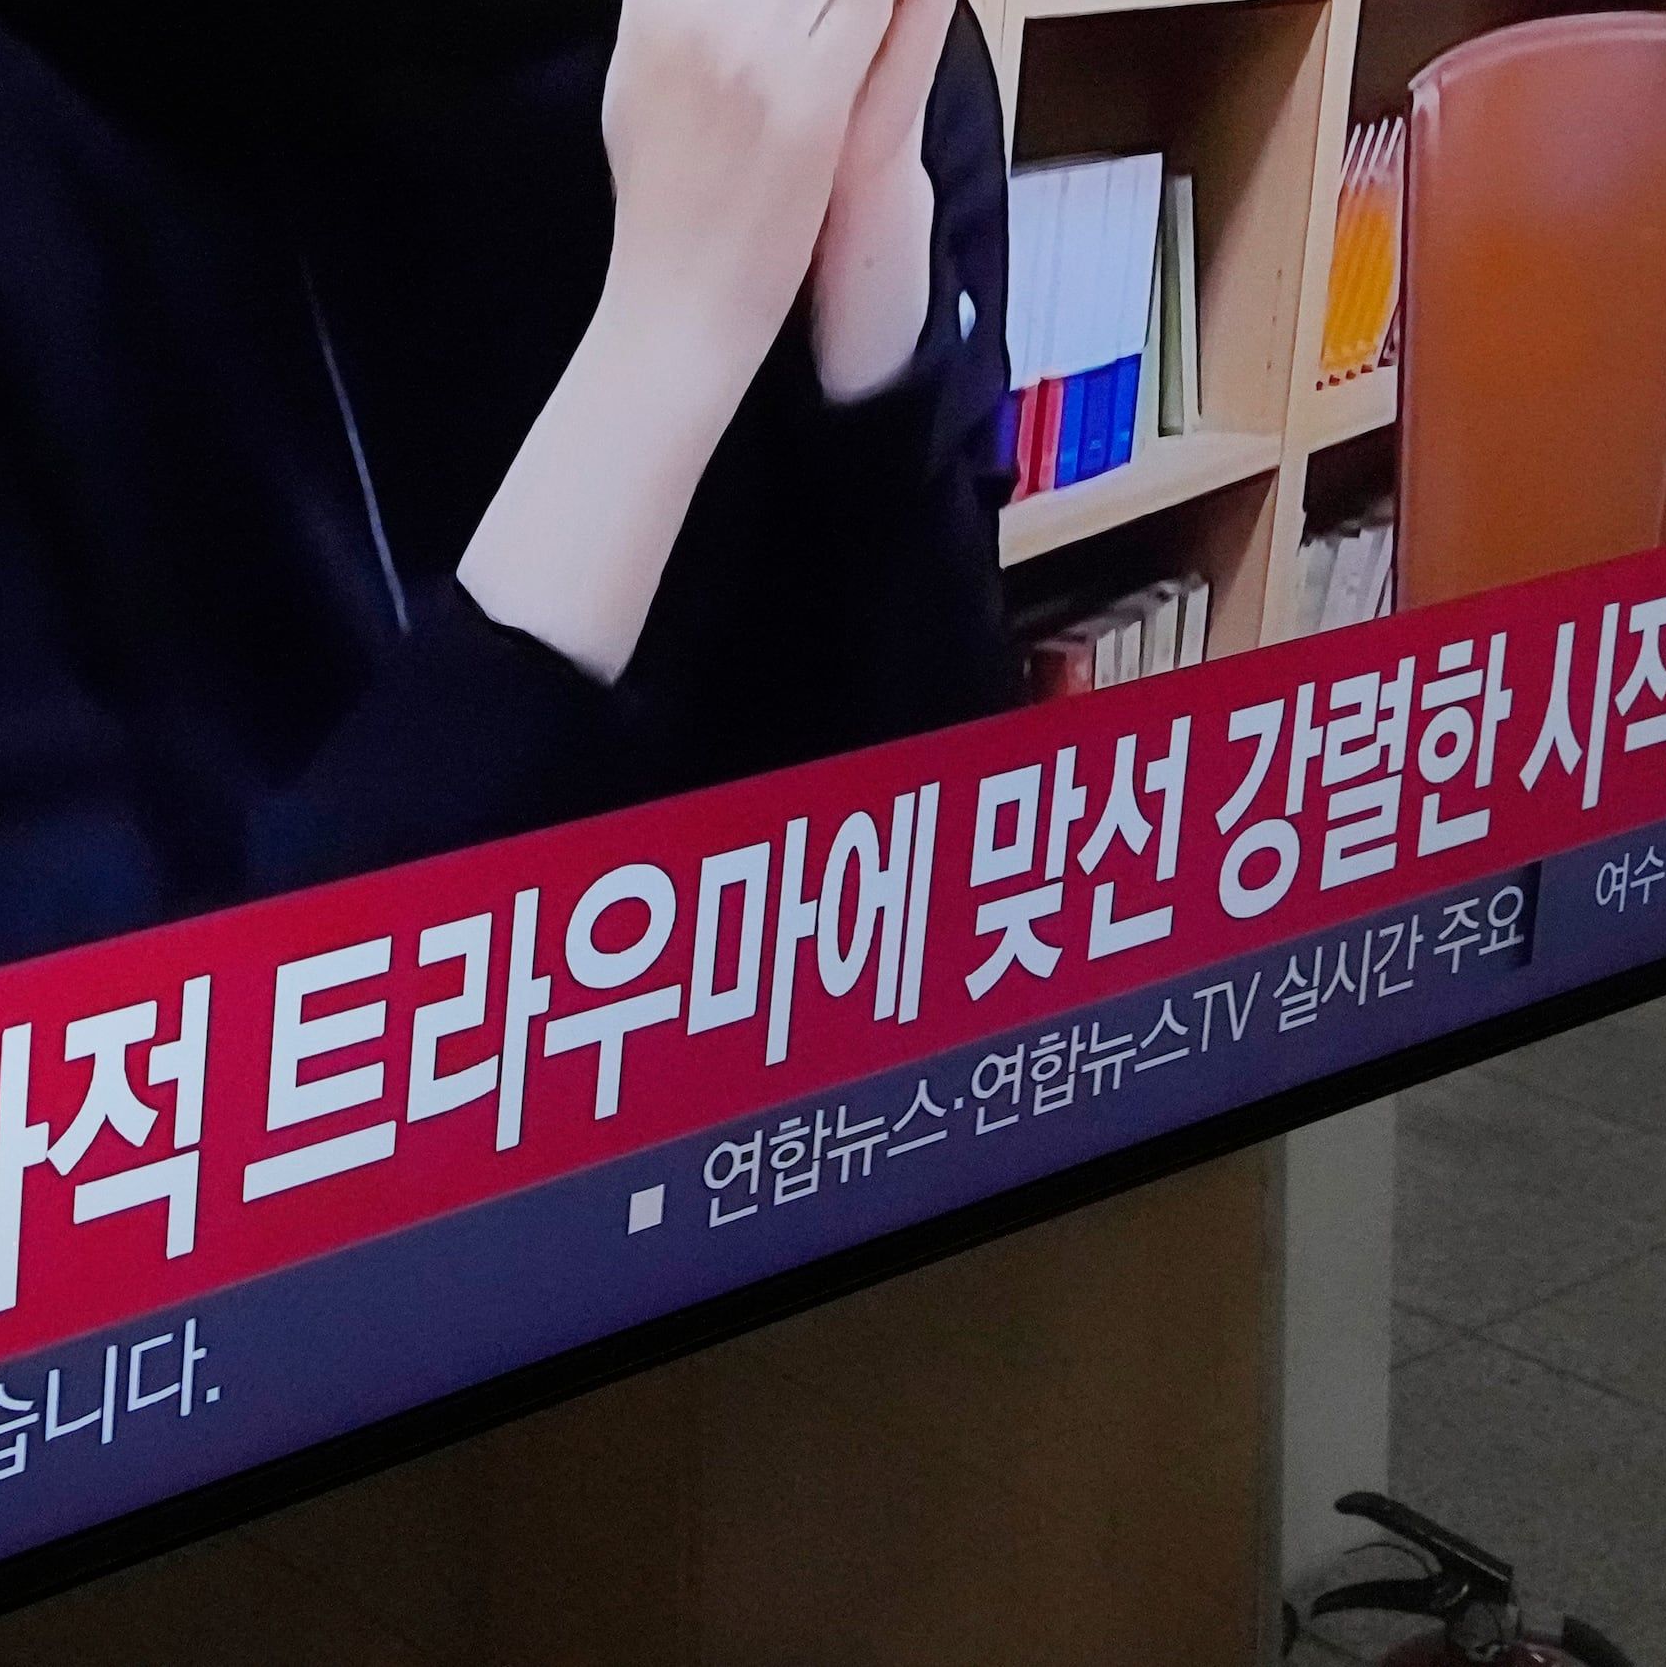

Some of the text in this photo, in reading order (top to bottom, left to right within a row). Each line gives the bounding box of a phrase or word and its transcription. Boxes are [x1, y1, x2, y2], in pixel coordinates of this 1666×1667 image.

[243, 781, 940, 1203] 트라우마에
[965, 715, 1192, 1002] 맞선
[1215, 632, 1513, 920] 강렬한
[1595, 845, 1666, 914] 여수
[1273, 912, 1425, 1032] 실시간
[1432, 885, 1526, 975] 주요
